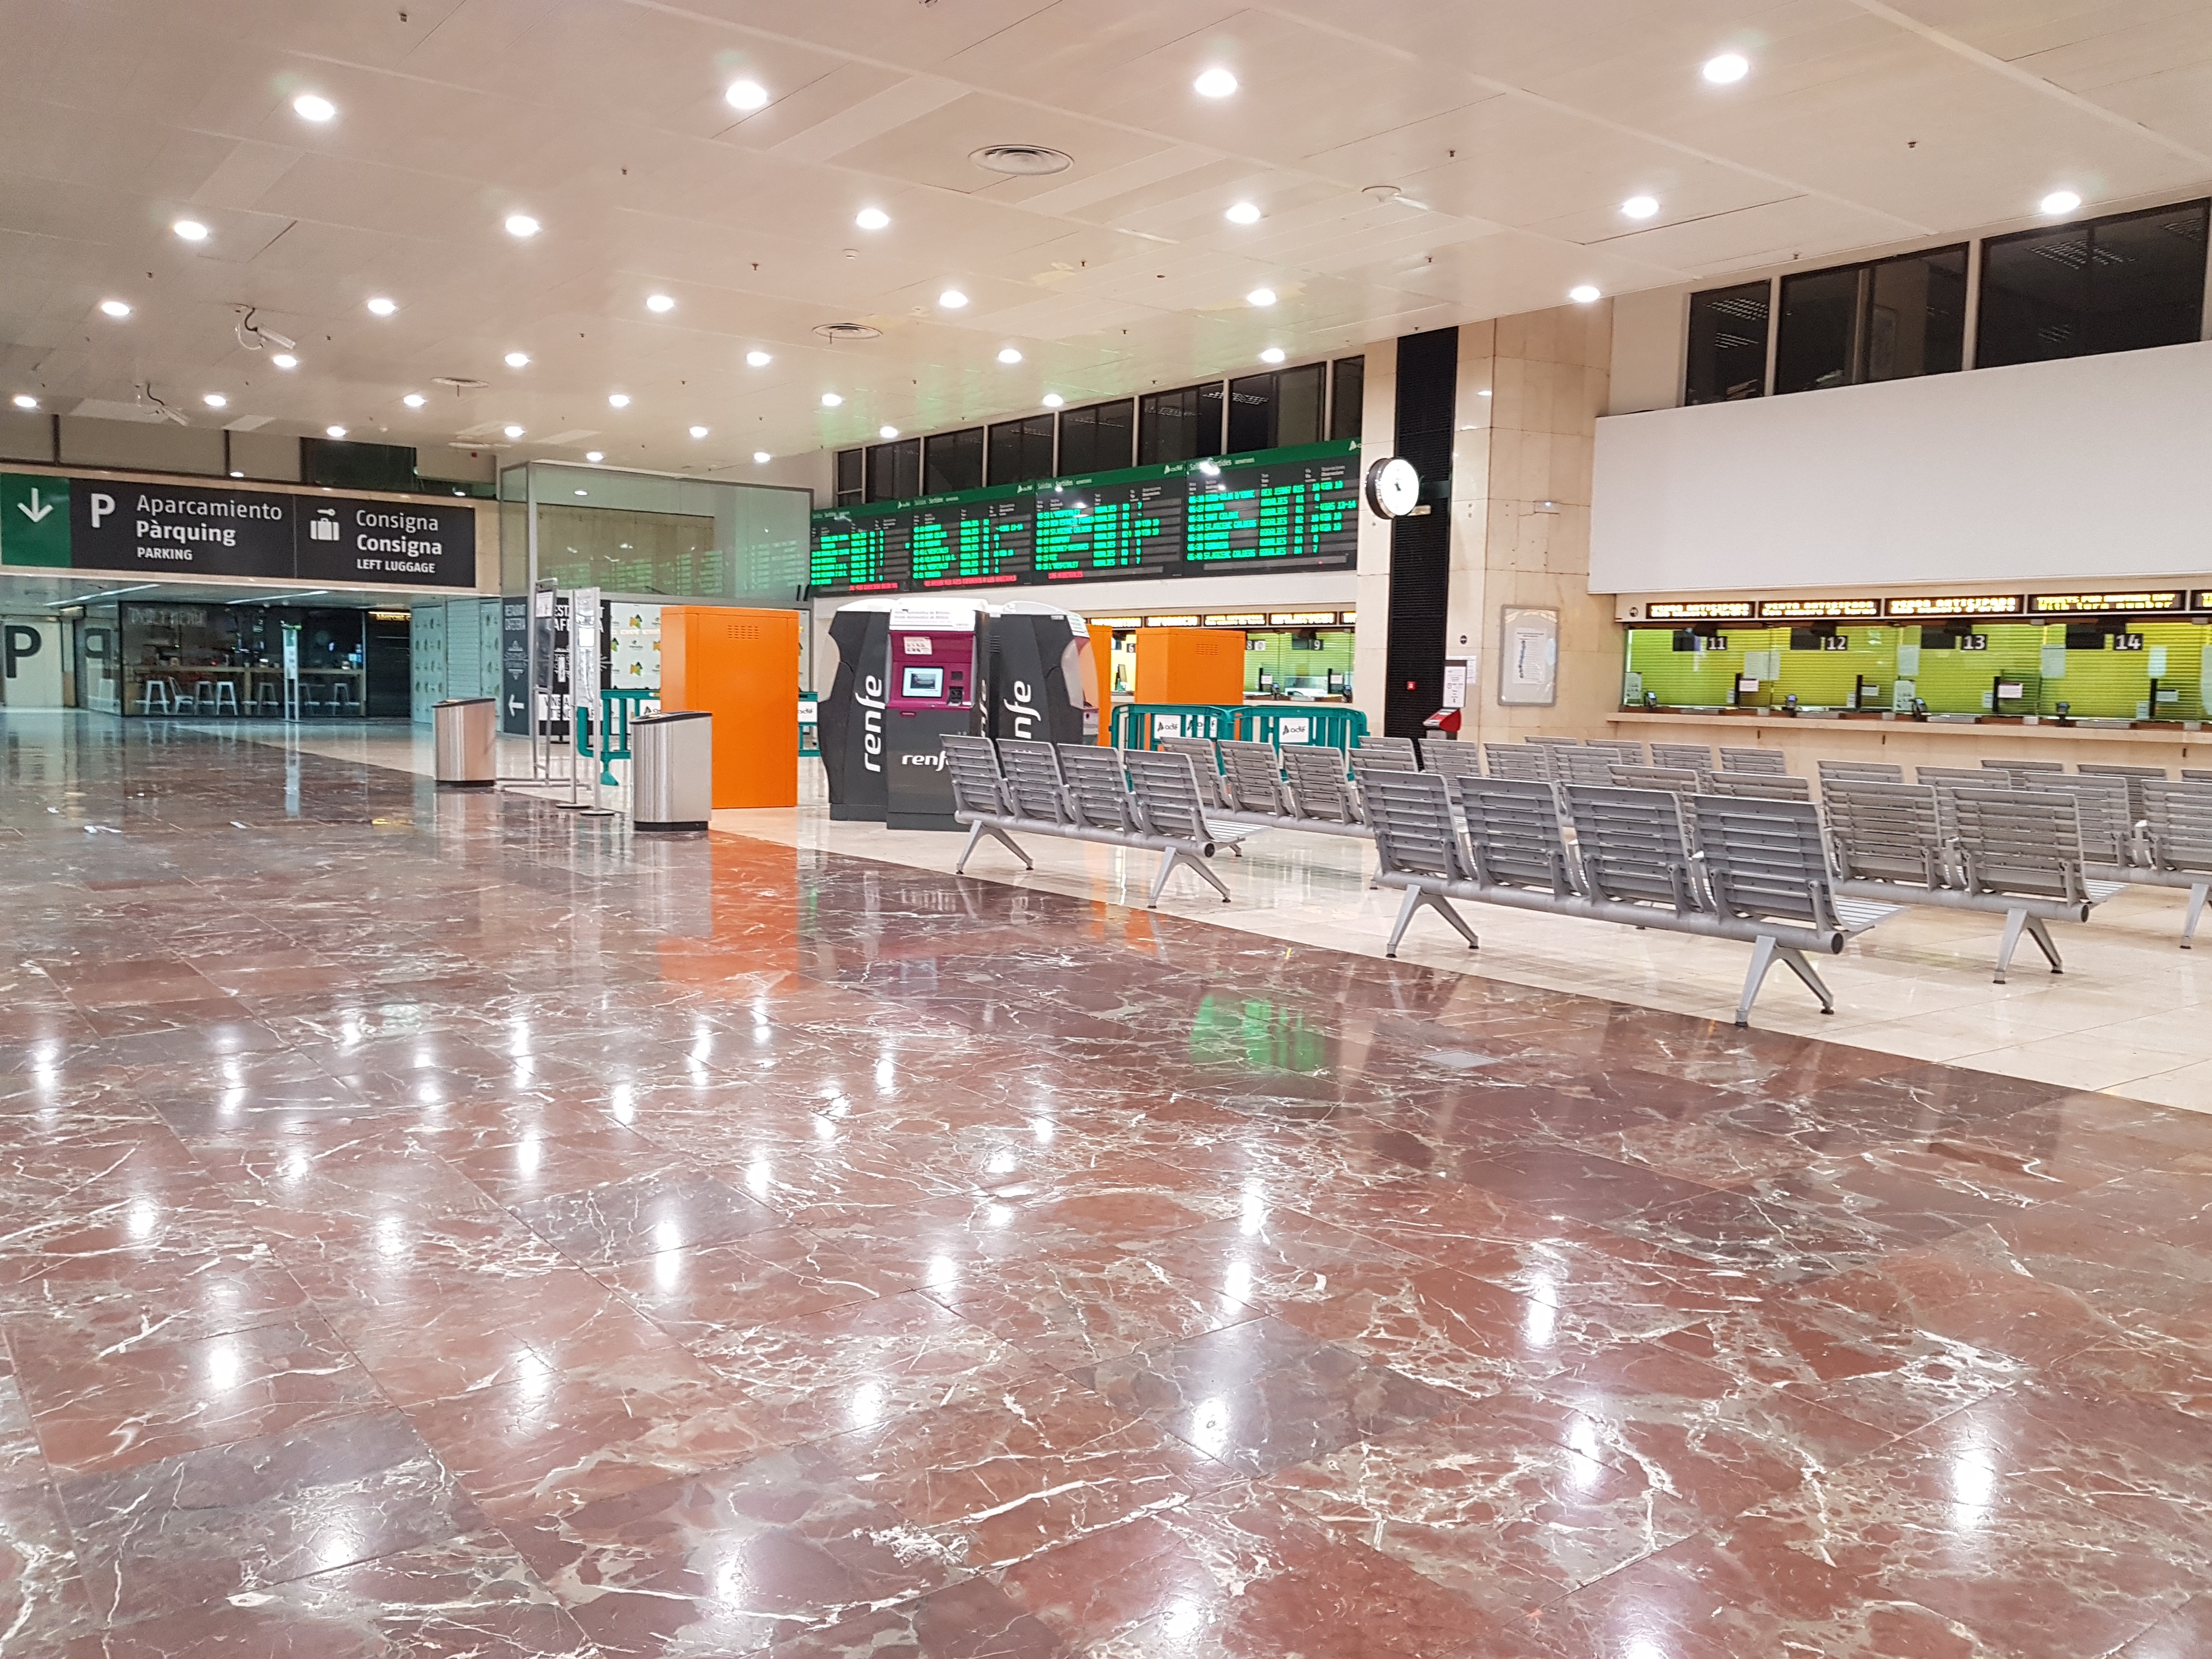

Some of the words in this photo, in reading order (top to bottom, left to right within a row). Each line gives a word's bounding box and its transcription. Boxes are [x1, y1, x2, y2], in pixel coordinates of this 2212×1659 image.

[91, 493, 115, 528] P
[136, 495, 283, 520] Aparcamiento
[357, 510, 438, 533] Consigna
[136, 520, 236, 546] Pàrquing
[137, 547, 193, 561] PARKING
[357, 534, 442, 557] Consigna
[357, 558, 382, 571] LEFT
[385, 561, 436, 573] LUGGAGE
[5, 625, 42, 678] P
[1129, 644, 1134, 652] 6
[1246, 640, 1252, 650] 8
[1314, 640, 1320, 650] 9
[1709, 637, 1725, 650] 11
[1827, 636, 1846, 650] 12
[1963, 635, 1985, 650] 13
[2115, 635, 2140, 650] 14
[1003, 680, 1042, 740] nfe
[855, 675, 886, 772] renfe
[902, 751, 949, 772] renf
